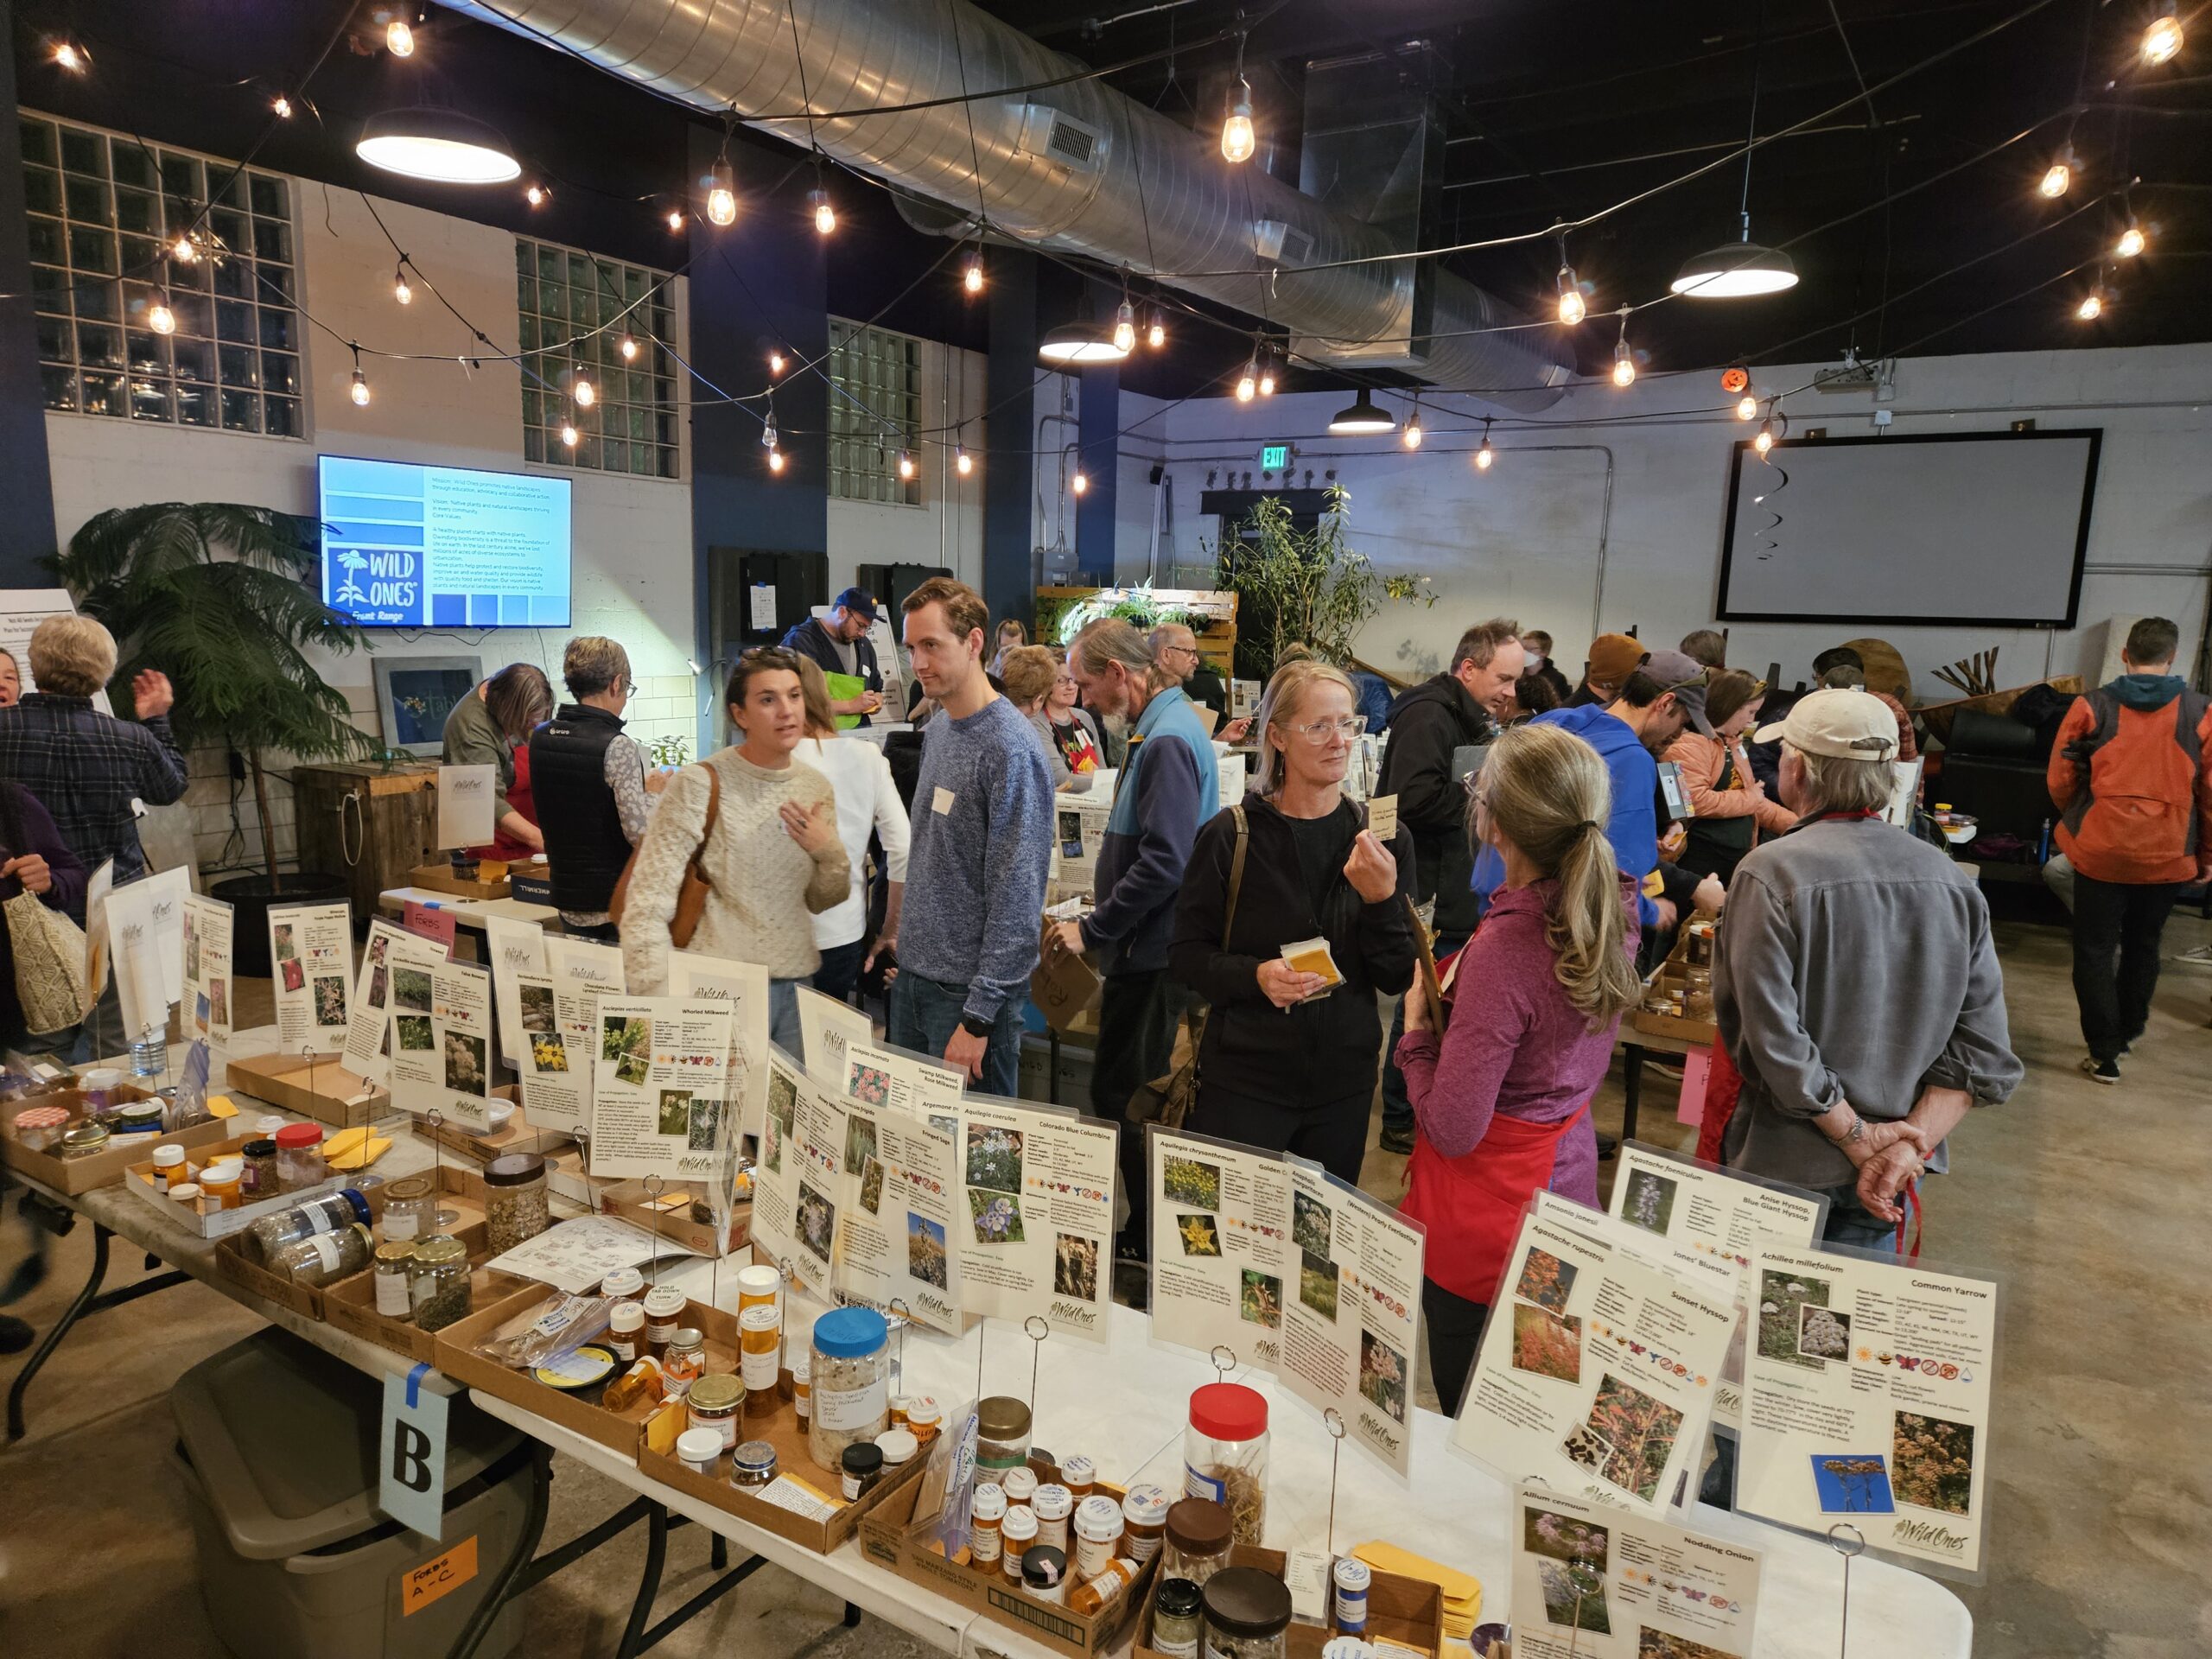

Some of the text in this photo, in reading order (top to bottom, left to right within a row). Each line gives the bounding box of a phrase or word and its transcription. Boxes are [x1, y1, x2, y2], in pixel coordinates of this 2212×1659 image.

[1264, 447, 1287, 467] EXIT
[370, 552, 415, 578] WILD
[370, 582, 415, 607] ONES
[378, 610, 404, 622] Range
[415, 913, 440, 930] FORBS
[584, 982, 605, 991] Chocolate
[851, 1046, 870, 1057] Asclepias
[918, 1067, 958, 1084] Swamp Milkweed,
[936, 1079, 958, 1091] Milkweed
[829, 1101, 846, 1117] Milkweed
[922, 1102, 952, 1111] Argemone
[964, 1109, 991, 1119] Aquilegia
[922, 1130, 950, 1146] Fringed Sage
[1039, 1121, 1111, 1141] Colorado Blue Columbine
[1160, 1141, 1236, 1163] Aquilegia chrysanthemum
[1258, 1164, 1281, 1174] Golden
[1629, 1154, 1703, 1181] Agastache foeniculum
[1545, 1201, 1574, 1217] Amsonia
[1743, 1197, 1809, 1222] Blue Giant Hyssop
[1760, 1194, 1810, 1215] Anise Hyssop,
[1347, 1199, 1418, 1246] (Western) Pearly Everlasting
[1533, 1224, 1605, 1263] Agastache rupestris
[1698, 1258, 1731, 1277] Bluestar
[1761, 1252, 1844, 1274] Achillea millefolium
[1911, 1279, 1987, 1299] Common Yarrow
[1055, 1302, 1097, 1324] Wild Ones
[1671, 1291, 1729, 1324] Sunset Hyssop
[393, 1418, 432, 1493] B
[1522, 1491, 1590, 1512] Allium cernuum
[1902, 1519, 1969, 1551] Wild Ones
[1684, 1536, 1754, 1562] Nodding Onion
[413, 1558, 449, 1583] FORBS
[412, 1586, 423, 1599] A
[438, 1569, 456, 1583] C
